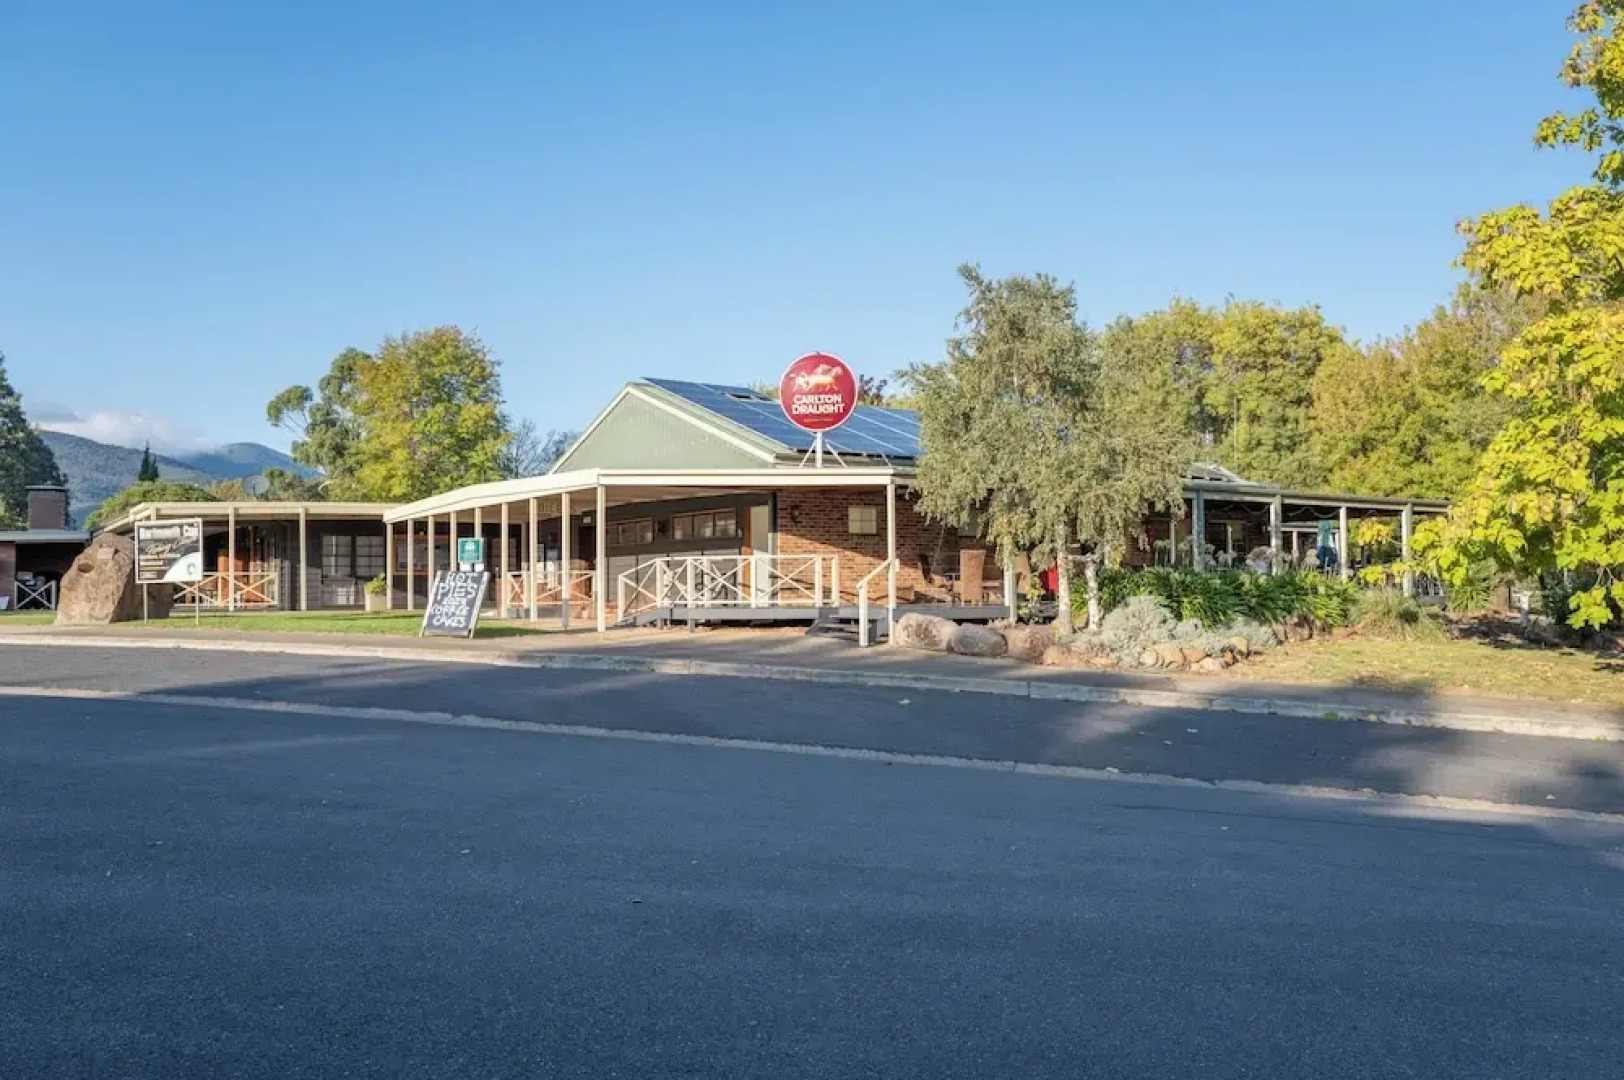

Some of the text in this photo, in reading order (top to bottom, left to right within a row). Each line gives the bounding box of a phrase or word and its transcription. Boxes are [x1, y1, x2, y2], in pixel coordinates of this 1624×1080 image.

[793, 394, 842, 404] CARLTON
[792, 404, 845, 414] DRAUGHT
[445, 573, 478, 583] HOT
[437, 582, 478, 600] PIES
